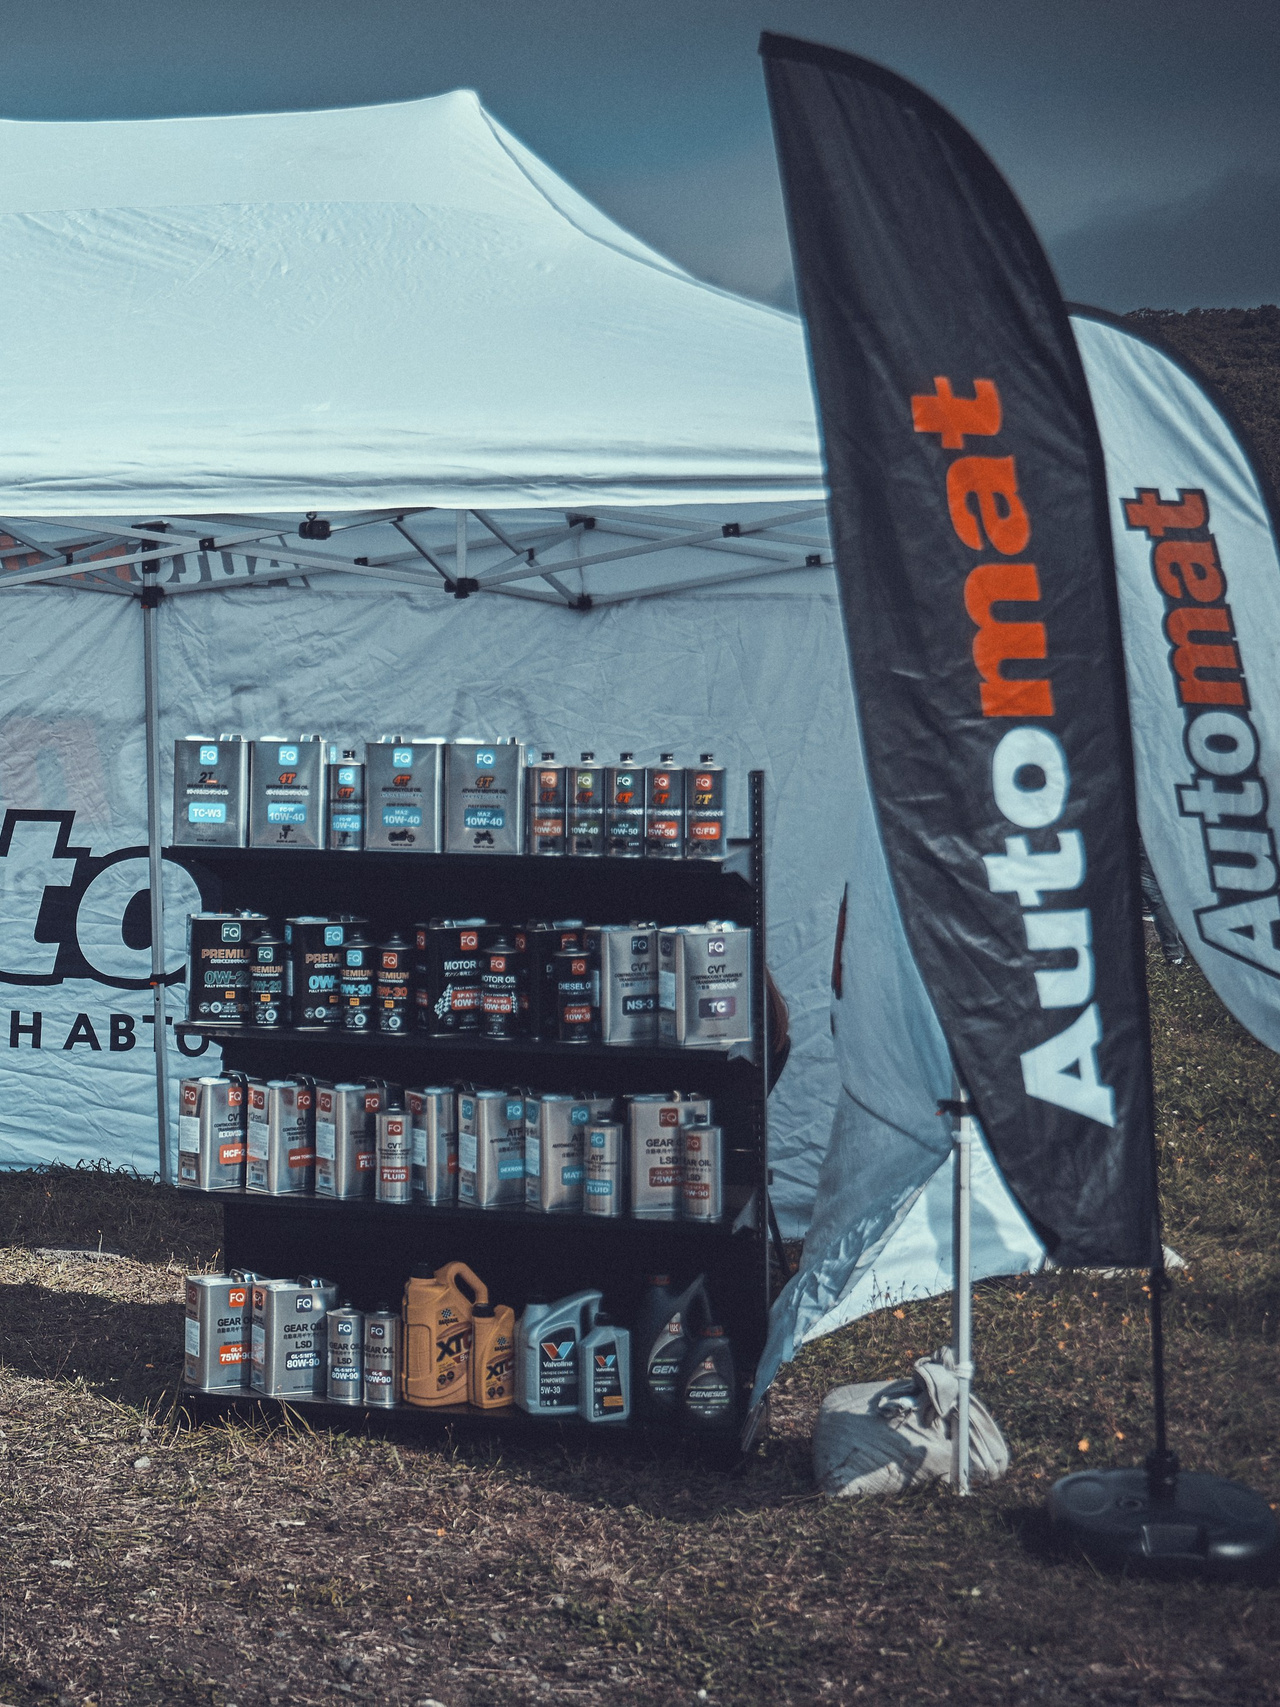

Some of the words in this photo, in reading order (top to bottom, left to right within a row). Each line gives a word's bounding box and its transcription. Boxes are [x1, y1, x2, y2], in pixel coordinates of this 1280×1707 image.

[200, 750, 217, 761] FQ
[279, 750, 297, 761] FQ
[911, 376, 1115, 1128] Automat
[394, 753, 411, 764] FQ
[476, 754, 493, 764] FQ
[279, 772, 297, 784] 4T
[339, 772, 352, 781] FQ
[392, 775, 411, 787] 4T
[541, 776, 555, 785] FQ
[577, 776, 591, 785] FQ
[475, 776, 494, 788] 4T
[617, 777, 631, 786] FQ
[654, 777, 667, 786] FQ
[696, 778, 710, 787] FQ
[193, 808, 222, 819] TC-W3
[269, 812, 305, 822] 10W-40
[384, 816, 420, 825] 10W-40
[465, 817, 503, 826] 10W-40
[223, 928, 239, 938] FQ
[326, 932, 341, 941] FQ
[461, 936, 477, 946] FQ
[632, 940, 647, 950] FQ
[708, 942, 724, 953] FQ
[201, 949, 251, 959] PREMIU
[259, 951, 272, 960] FQ
[347, 954, 361, 962] FQ
[384, 956, 396, 965] FQ
[490, 960, 505, 969] FQ
[444, 961, 476, 970] MOTOR
[572, 963, 585, 972] FQ
[631, 963, 648, 972] CVT
[708, 965, 726, 974] CVT
[204, 971, 247, 985] 0W-2
[558, 982, 585, 990] DIESEL
[484, 1003, 510, 1011] 10W-60
[627, 1000, 653, 1010] NS-3
[708, 1002, 726, 1012] TC
[185, 1091, 196, 1101] FQ
[229, 1091, 242, 1101] FQ
[298, 1096, 311, 1105] FQ
[365, 1098, 379, 1108] FQ
[507, 1105, 522, 1116] FQ
[571, 1111, 588, 1121] FQ
[660, 1113, 677, 1123] FQ
[388, 1124, 402, 1133] FQ
[590, 1136, 603, 1145] FQ
[646, 1139, 674, 1147] GEAR
[687, 1140, 699, 1149] FQ
[699, 1159, 711, 1167] OIL
[230, 1293, 244, 1303] FQ
[297, 1299, 312, 1308] FQ
[217, 1318, 242, 1327] GEAR
[284, 1324, 308, 1333] GEAR
[338, 1323, 351, 1332] FQ
[370, 1327, 384, 1336] FQ
[295, 1340, 312, 1349] LSD
[287, 1358, 320, 1369] 80W-90
[337, 1357, 352, 1365] LSD
[332, 1372, 358, 1380] 80W-90
[540, 1386, 560, 1395] 5W-30
[689, 1390, 727, 1398] GENESIS
